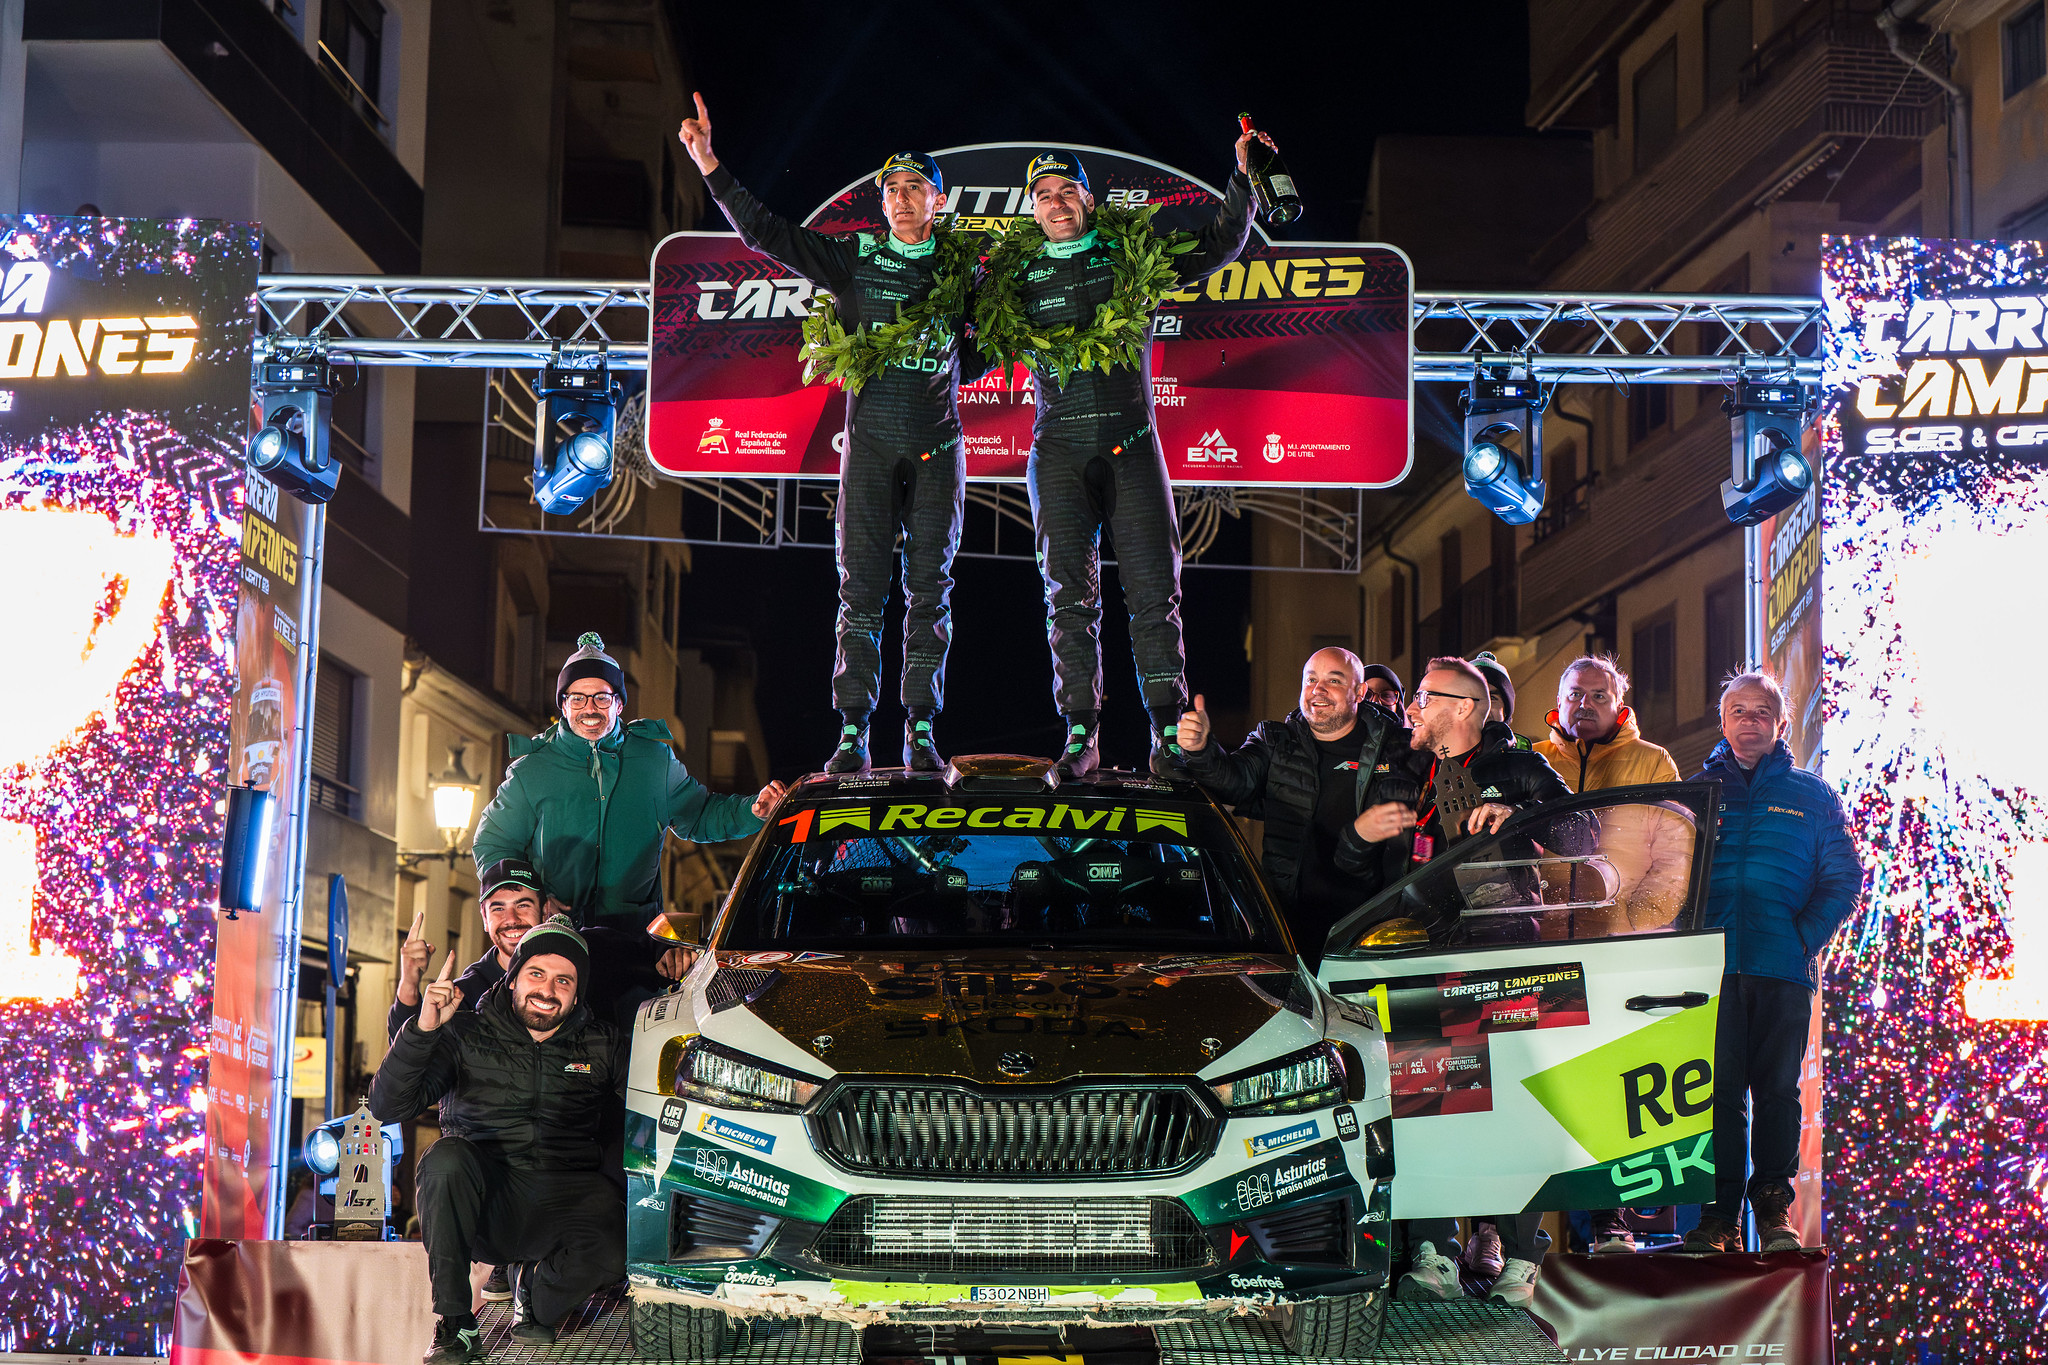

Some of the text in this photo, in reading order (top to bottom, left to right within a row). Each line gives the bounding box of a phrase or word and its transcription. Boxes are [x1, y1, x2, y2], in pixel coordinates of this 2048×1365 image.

[1031, 163, 1068, 178] MICHELIN
[1106, 189, 1149, 202] 20
[882, 289, 909, 299] Asturias
[1039, 297, 1066, 307] Asturias
[735, 430, 787, 439] Real Federación
[1971, 427, 1988, 448] &
[735, 447, 786, 455] Automovilismo
[740, 439, 781, 447] Española de
[972, 446, 1009, 455] València
[1187, 447, 1238, 463] ENR
[1770, 481, 1816, 581] CARRERA
[878, 804, 1128, 832] Recalvi
[1774, 806, 1798, 816] Recalvi
[780, 810, 815, 843] 1
[1089, 866, 1120, 879] OMP
[1443, 970, 1580, 998] CARRERA CAMPEONES
[1368, 984, 1391, 1033] 1
[1492, 1011, 1530, 1021] UTIEL
[1445, 1058, 1477, 1066] COMUNITAT
[1620, 1057, 1713, 1139] Re
[664, 1103, 683, 1119] UFI
[1336, 1111, 1354, 1127] UFI
[661, 1114, 680, 1129] FILTERS
[1339, 1124, 1357, 1135] FILTERS
[717, 1124, 769, 1148] MICHELIN
[1267, 1126, 1313, 1148] MICHELIN
[1273, 1156, 1327, 1188] Asturias
[1610, 1131, 1715, 1203] SK
[731, 1160, 790, 1197] Asturias
[1303, 1170, 1329, 1190] natural
[1634, 1345, 1739, 1360] CIUDAD
[1745, 1343, 1785, 1357] DE
